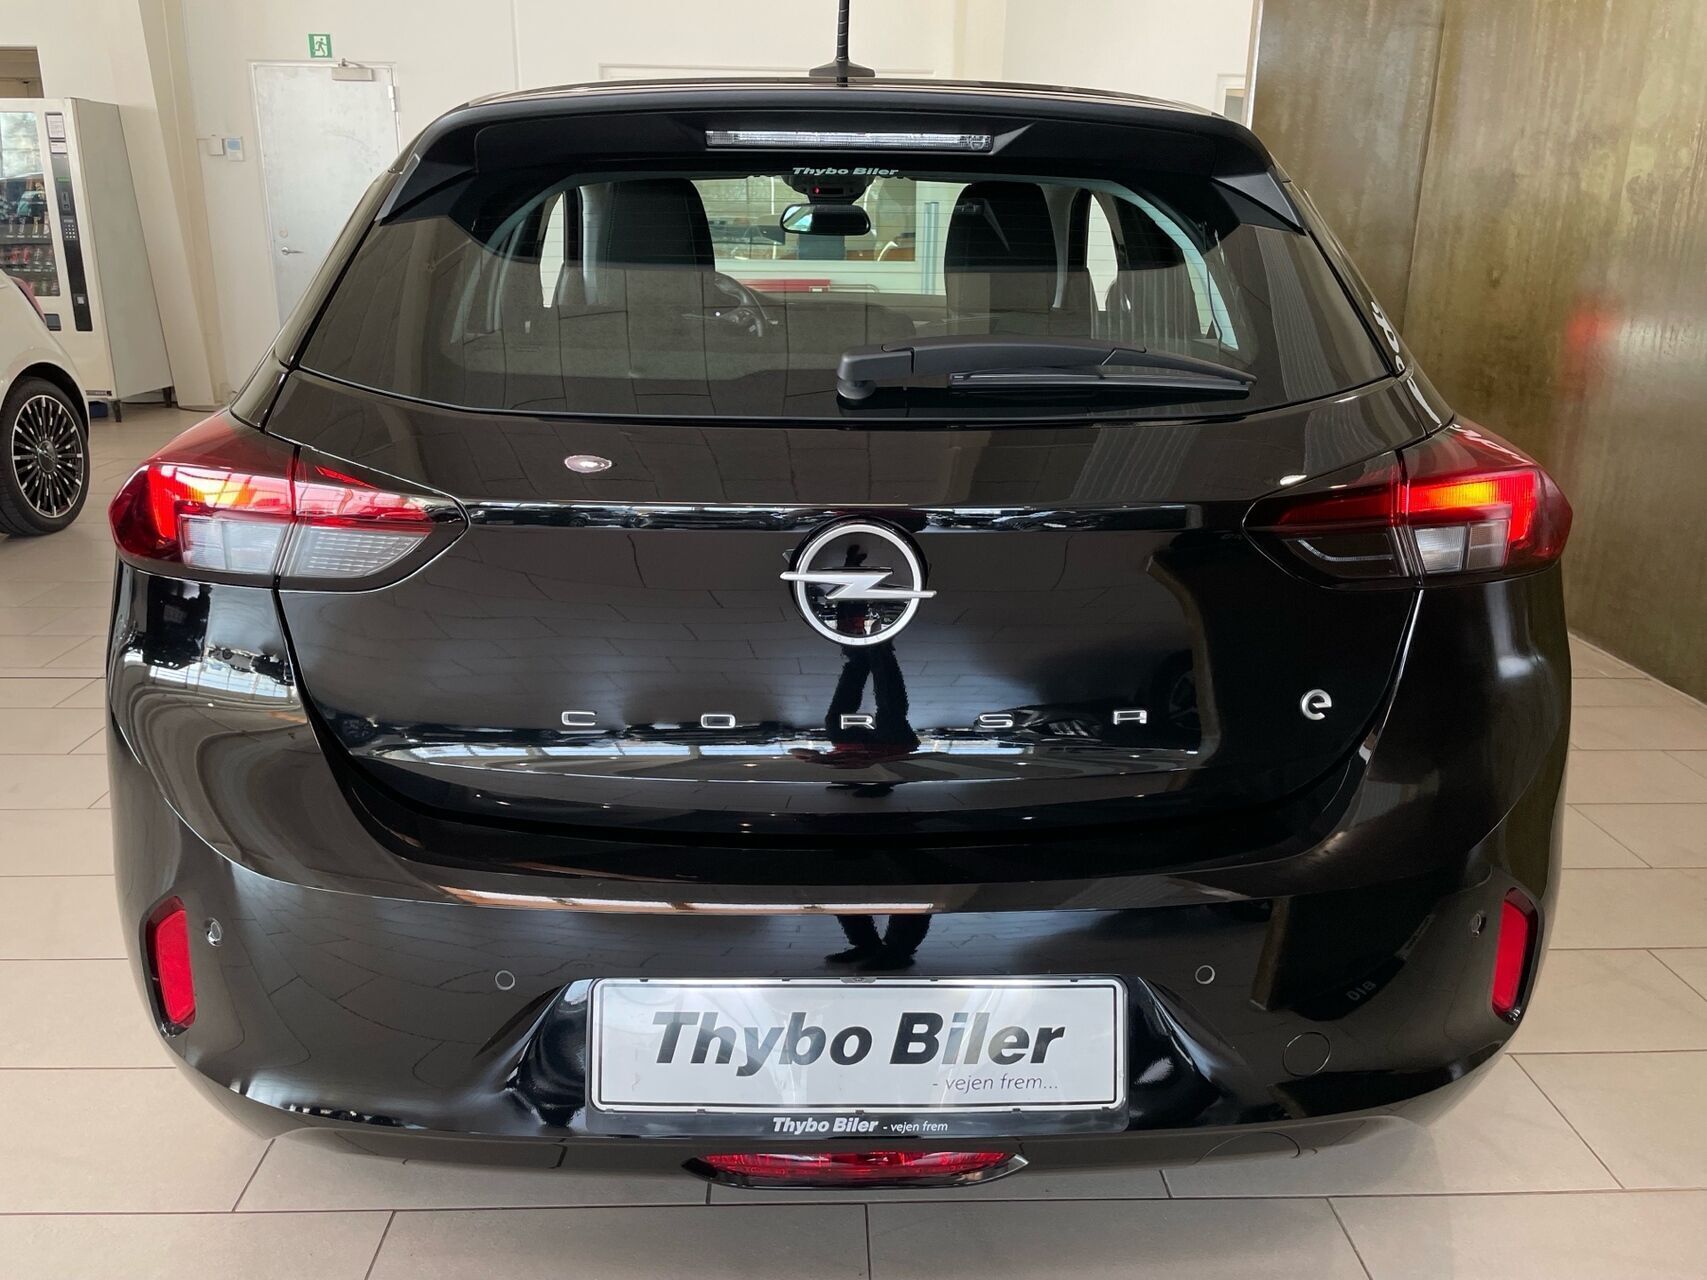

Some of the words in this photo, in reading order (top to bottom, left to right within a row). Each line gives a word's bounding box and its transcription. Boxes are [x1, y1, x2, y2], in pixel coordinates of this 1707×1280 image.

[792, 167, 849, 176] Thybo
[852, 167, 899, 175] Biler
[561, 710, 1148, 729] CORSA
[652, 1011, 873, 1077] Thybo
[890, 1011, 1065, 1065] Biler
[946, 1074, 994, 1093] vejen
[1000, 1073, 1058, 1091] frem...
[773, 1118, 829, 1135] Thybo
[833, 1118, 878, 1132] Biler
[890, 1123, 918, 1133] vejen
[922, 1121, 948, 1131] frem
